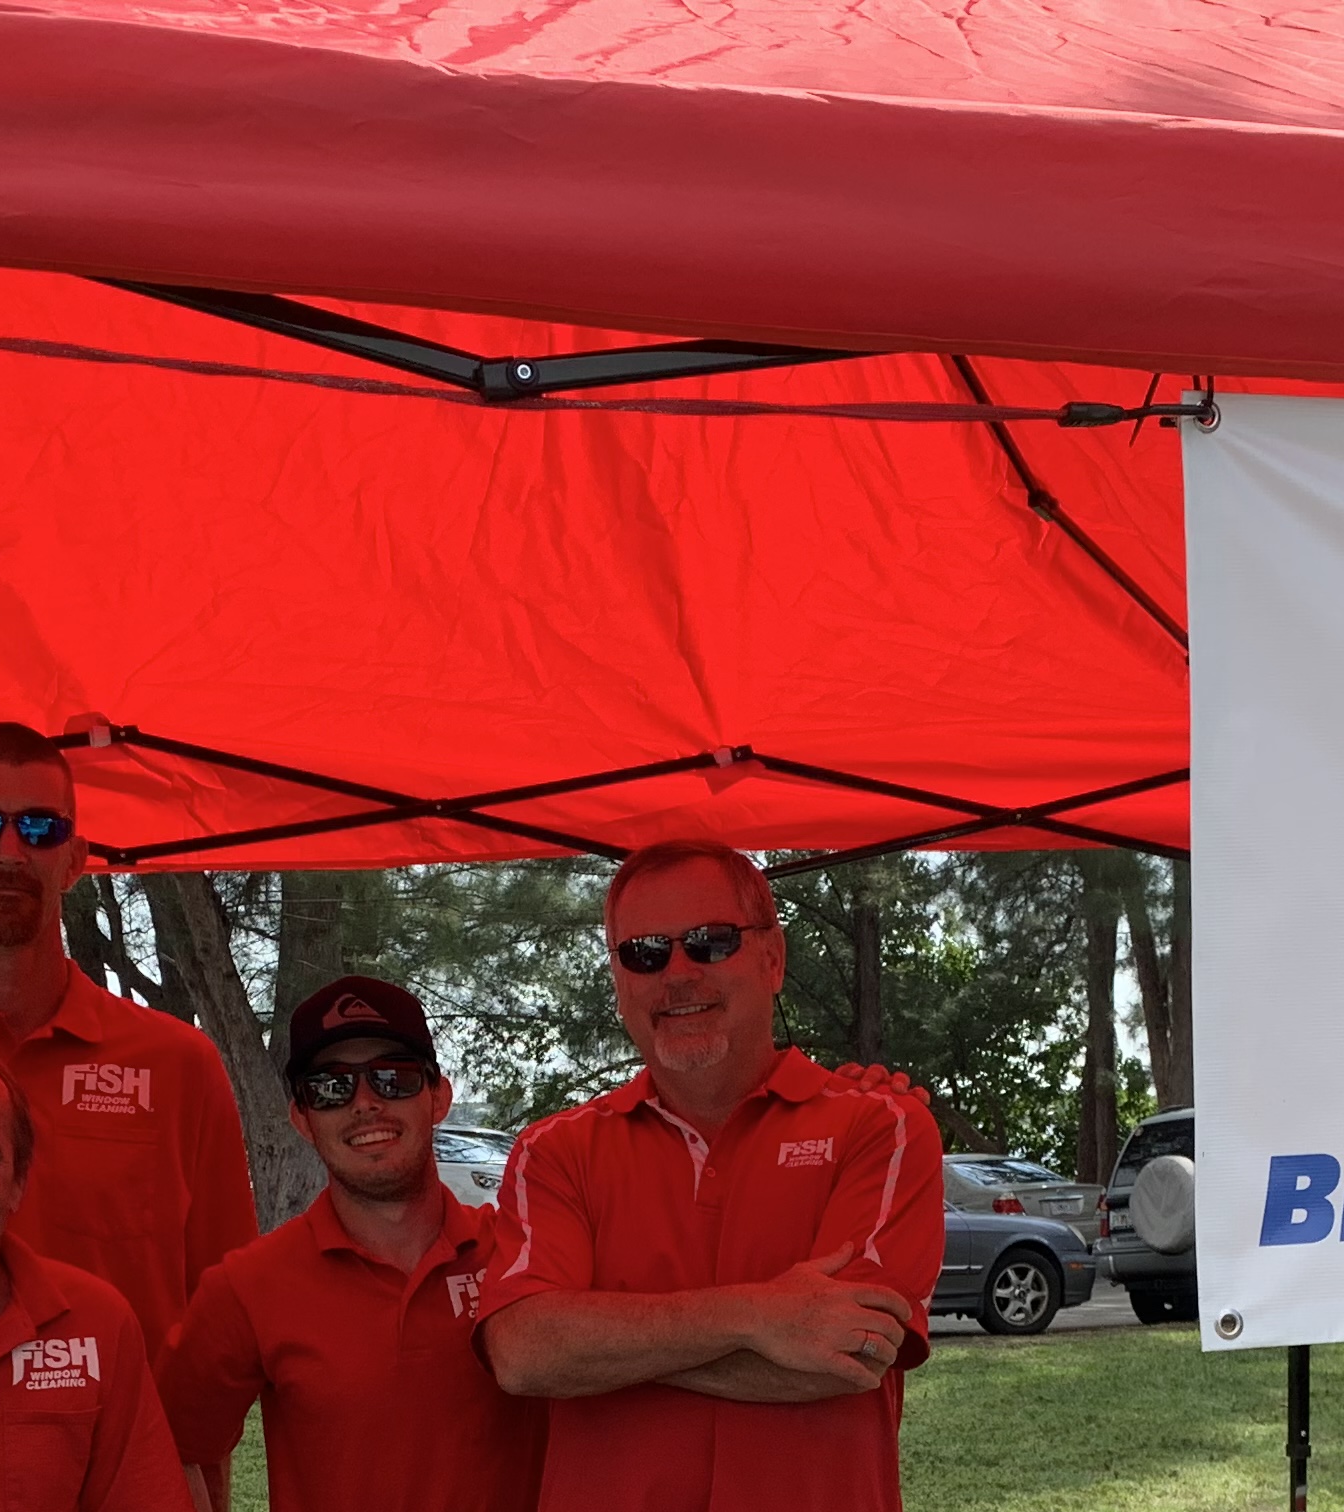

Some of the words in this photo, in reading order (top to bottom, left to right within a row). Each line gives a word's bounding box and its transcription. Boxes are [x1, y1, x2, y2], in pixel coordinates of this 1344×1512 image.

[81, 1094, 131, 1105] WINDOW
[77, 1103, 136, 1114] CLEANING
[30, 1369, 81, 1380] WINDOW
[26, 1378, 86, 1390] CLEANING
